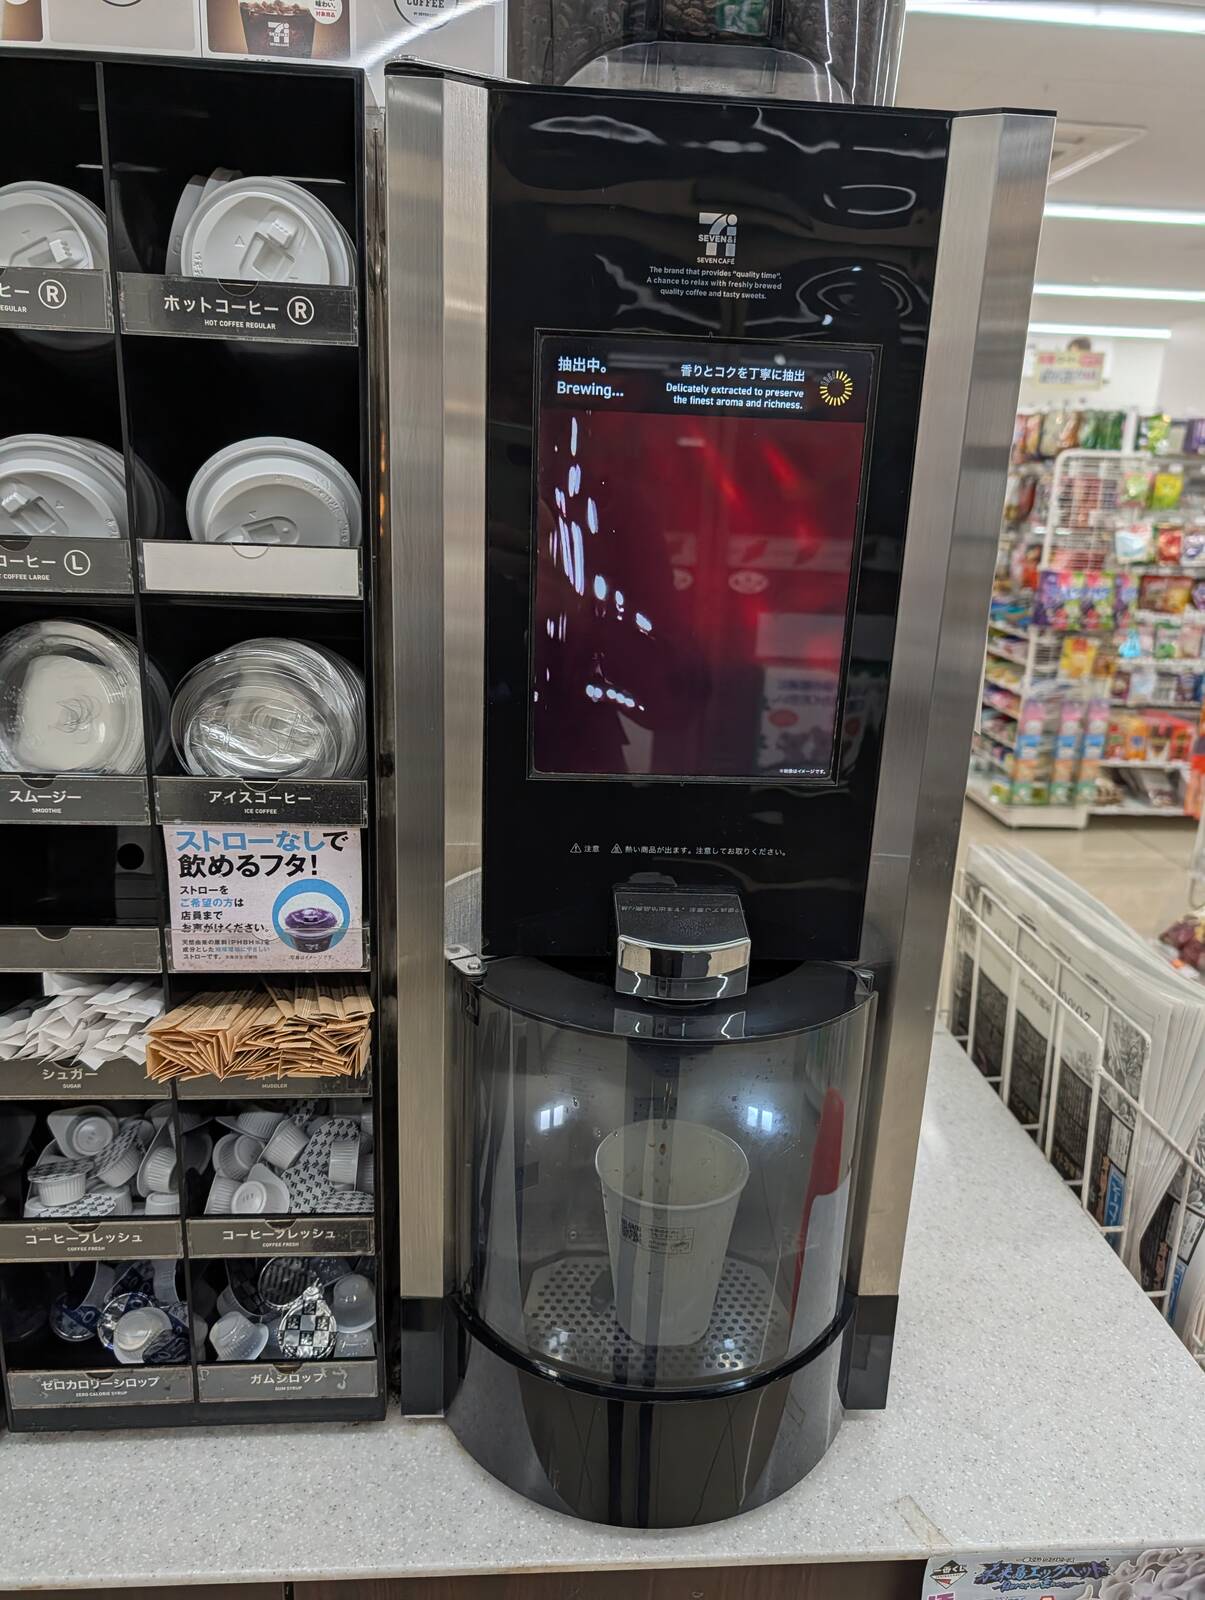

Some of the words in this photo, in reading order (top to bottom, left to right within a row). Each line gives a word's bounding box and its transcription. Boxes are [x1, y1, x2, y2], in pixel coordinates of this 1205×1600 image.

[650, 266, 662, 274] The
[702, 269, 732, 278] provides
[646, 276, 652, 284] A
[654, 277, 680, 285] chance
[690, 278, 708, 286] relax
[728, 280, 752, 289] freshly
[754, 282, 782, 290] brewed
[660, 288, 684, 296] quality
[686, 288, 707, 296] coffee
[723, 291, 741, 299] tasty
[742, 292, 767, 300] sweets.
[164, 294, 279, 315] ホットコーヒー
[220, 320, 244, 328] COFFEE
[246, 322, 276, 330] REGULAR
[557, 356, 607, 374] 抽出中。
[680, 364, 805, 382] 香りとコクを丁寧に抽出
[556, 380, 624, 399] Brewing...
[666, 382, 709, 395] Delicately
[711, 386, 752, 396] extracted
[754, 388, 763, 396] to
[764, 389, 804, 398] preserve
[673, 395, 688, 404] the
[690, 396, 714, 405] finest
[716, 398, 744, 406] aroma
[746, 399, 762, 408] and
[764, 400, 803, 409] richness.
[9, 790, 82, 804] スムージー
[208, 790, 312, 804] アイスコーヒー
[176, 830, 349, 852] ストローなしで
[178, 854, 318, 878] 飲めるフタ!
[180, 885, 228, 895] ストローを
[180, 898, 244, 908] ご希望の方は
[181, 911, 222, 920] 店員まで
[182, 923, 270, 933] お声がけください。
[42, 1068, 98, 1080] シュガー
[25, 1233, 142, 1244] コーヒーフレッシュ
[222, 1228, 336, 1240] コーヒーフレッシュ
[41, 1376, 160, 1390] ゼロカロリーシロップ
[250, 1373, 323, 1384] ガムシロップ
